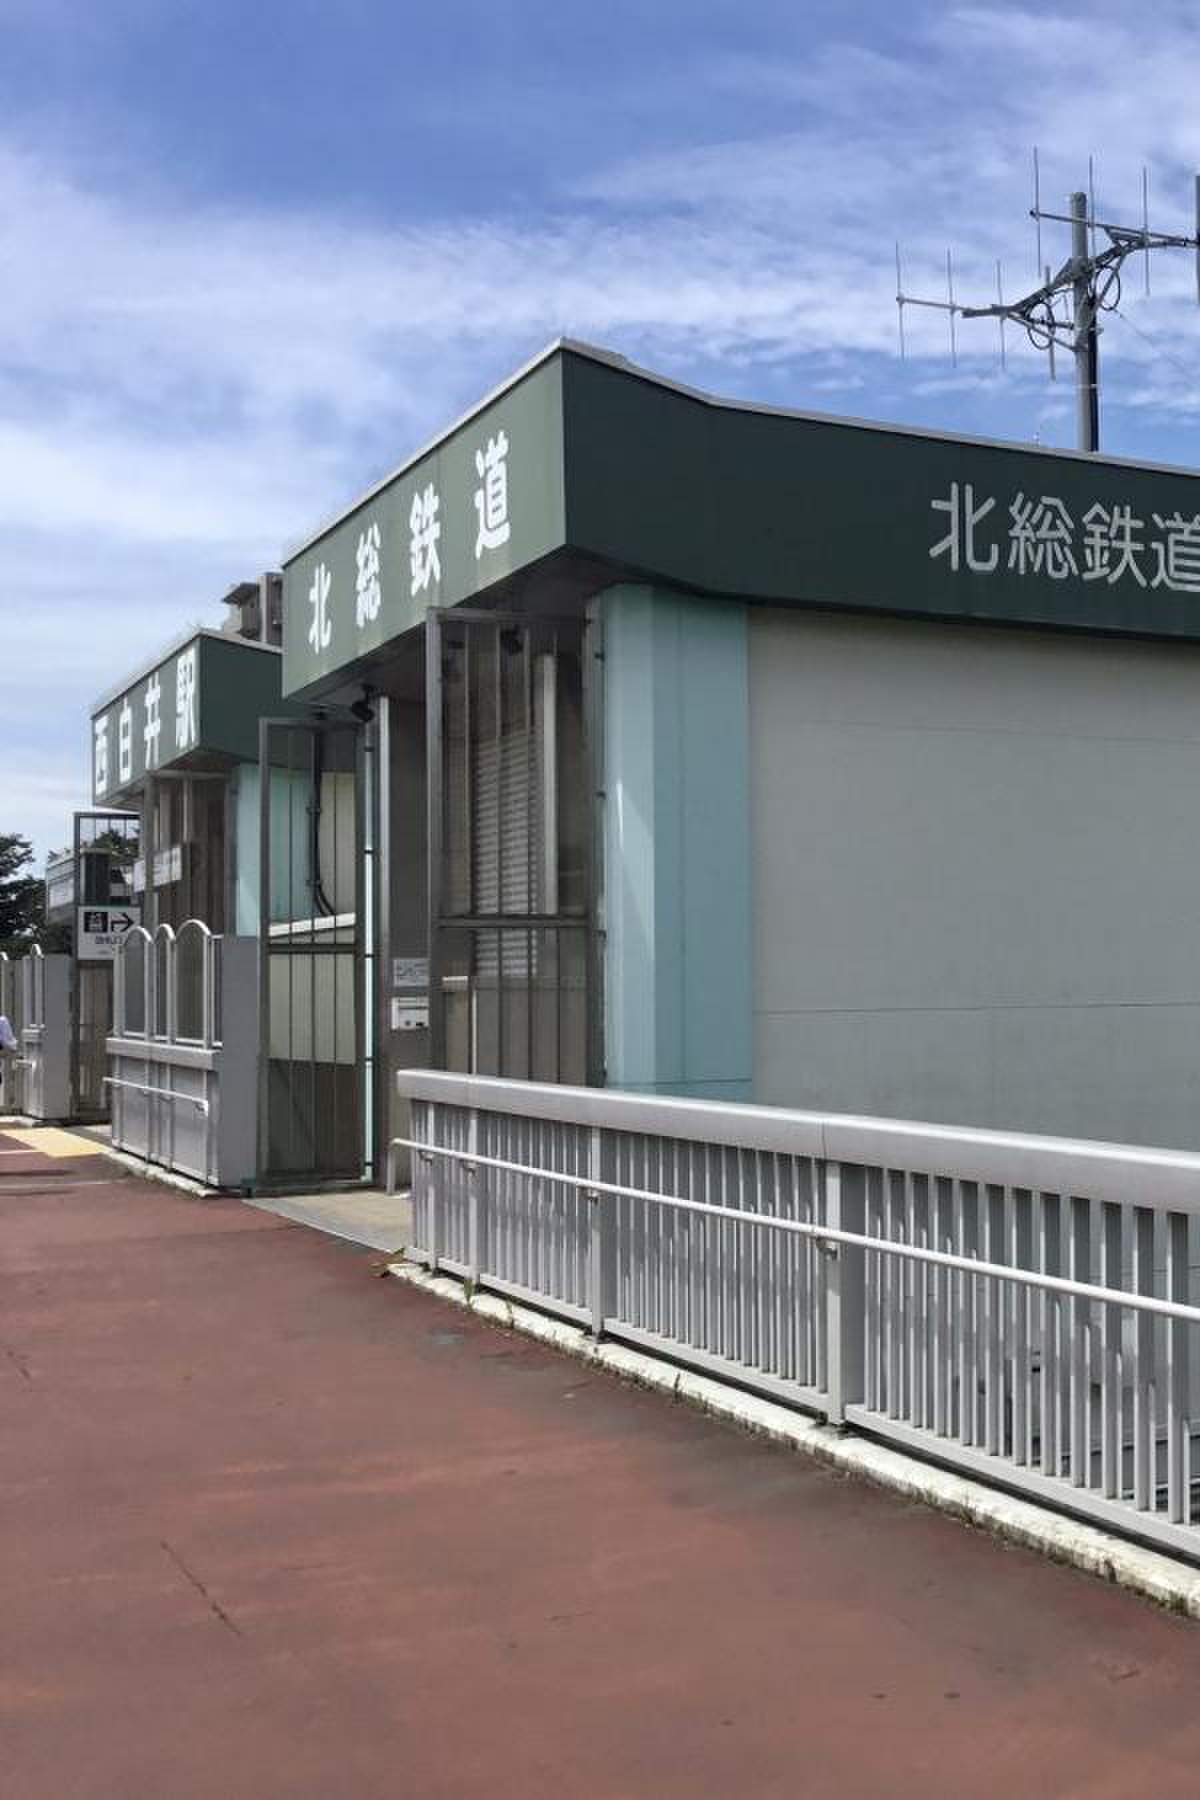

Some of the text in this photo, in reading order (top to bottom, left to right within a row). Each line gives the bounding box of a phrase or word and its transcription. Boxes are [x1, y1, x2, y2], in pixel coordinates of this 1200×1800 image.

[308, 429, 511, 654] 北総鉄道
[95, 646, 196, 796] 西白井駅
